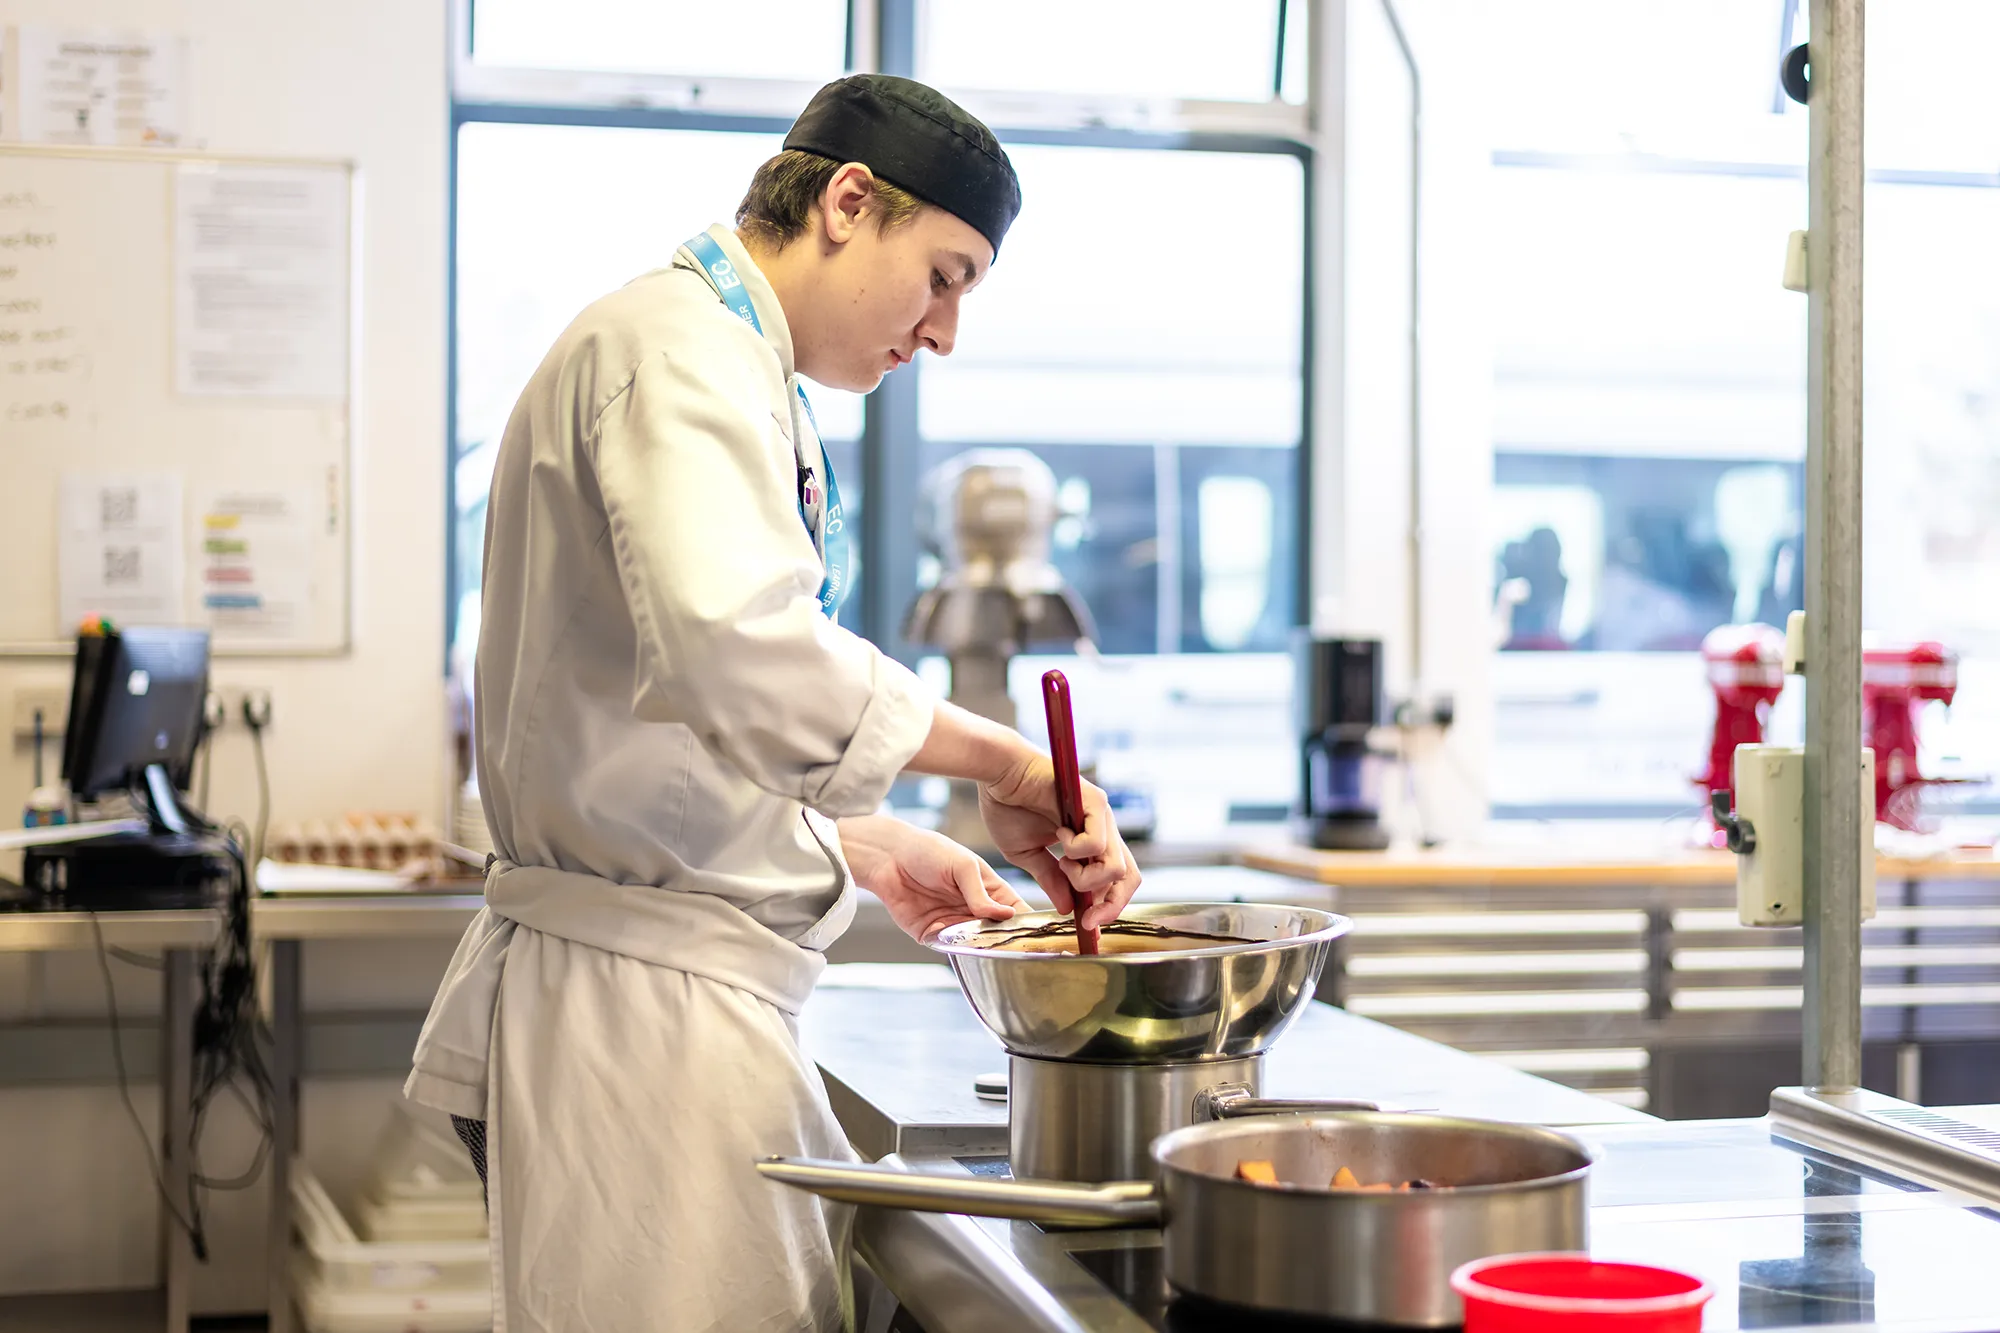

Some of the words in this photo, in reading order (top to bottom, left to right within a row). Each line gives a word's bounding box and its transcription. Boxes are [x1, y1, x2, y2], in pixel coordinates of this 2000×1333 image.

[711, 259, 741, 290] EC
[826, 504, 843, 535] EC
[822, 563, 841, 608] LEARNER
